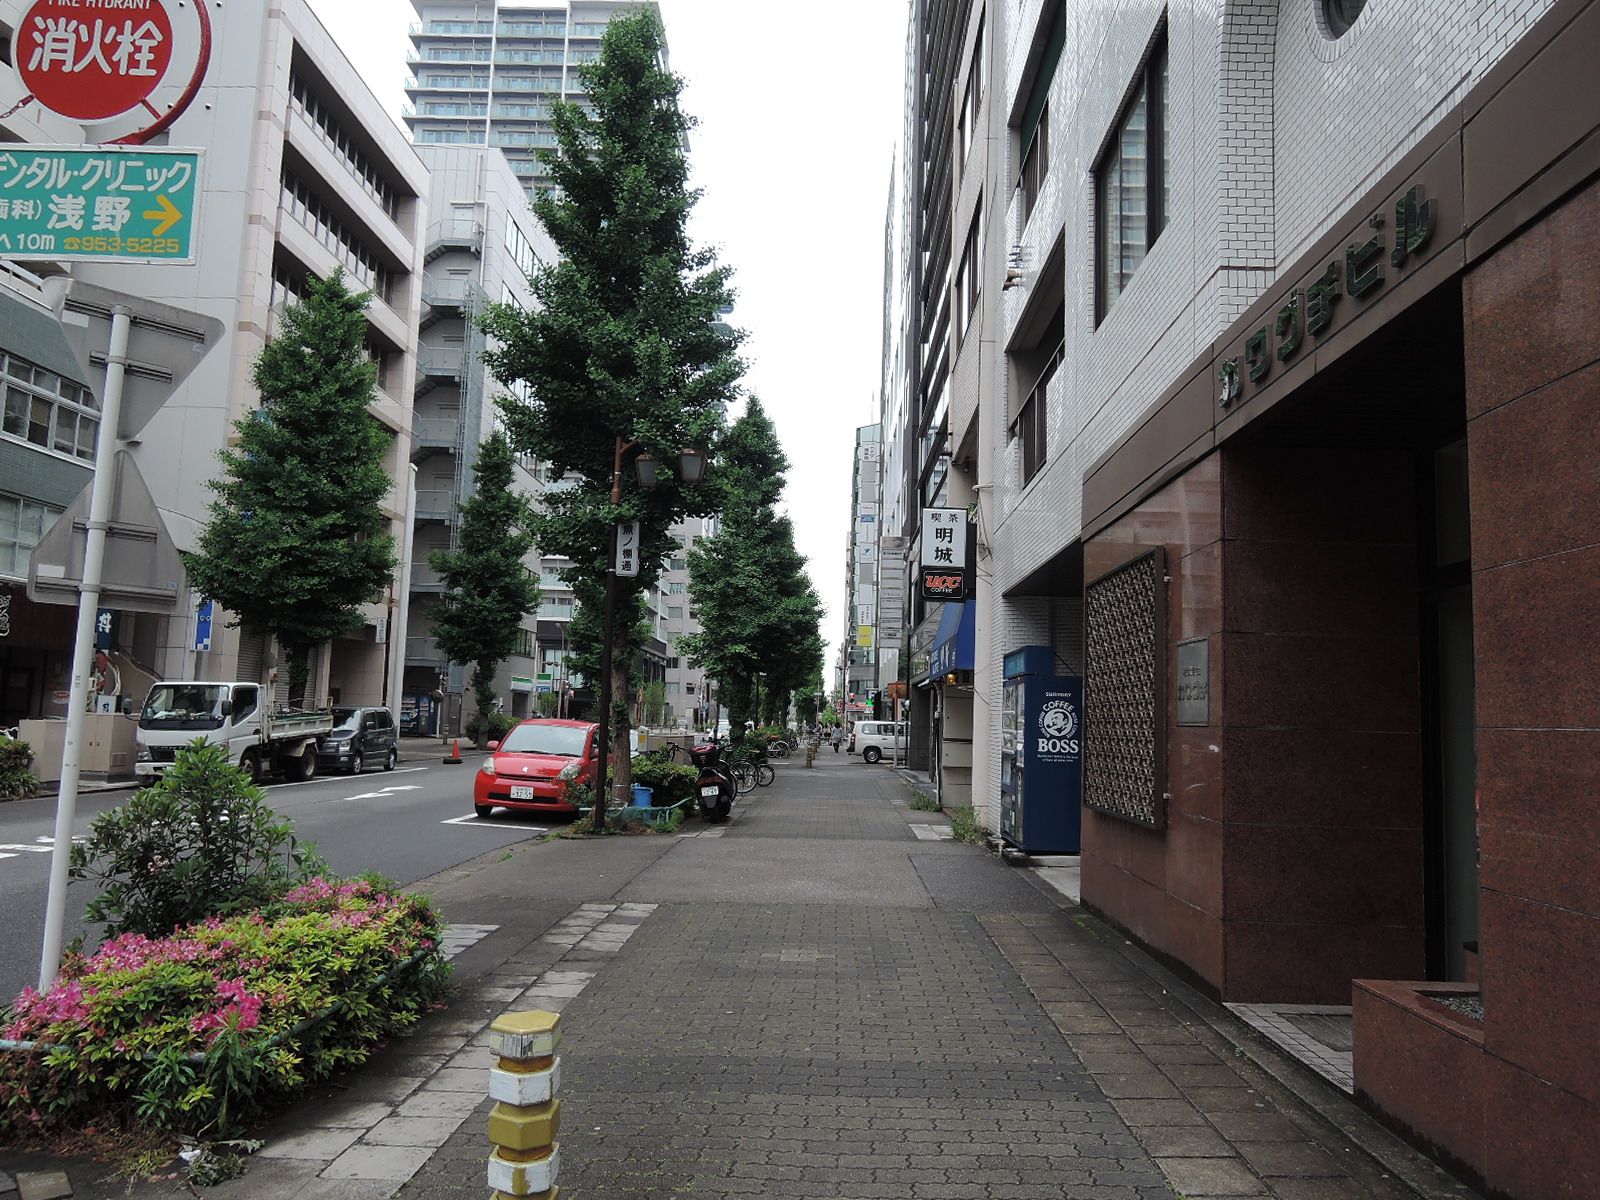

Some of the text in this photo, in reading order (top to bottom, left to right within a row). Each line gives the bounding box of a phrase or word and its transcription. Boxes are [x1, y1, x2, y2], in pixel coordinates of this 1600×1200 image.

[28, 16, 164, 76] 消火栓
[47, 193, 132, 232] 浅野
[81, 236, 180, 253] 953-5225
[931, 512, 959, 523] 喫茶
[934, 527, 954, 564] 明城
[925, 575, 961, 589] UCC
[1042, 700, 1075, 712] COFFEE
[1037, 738, 1079, 753] BOSS
